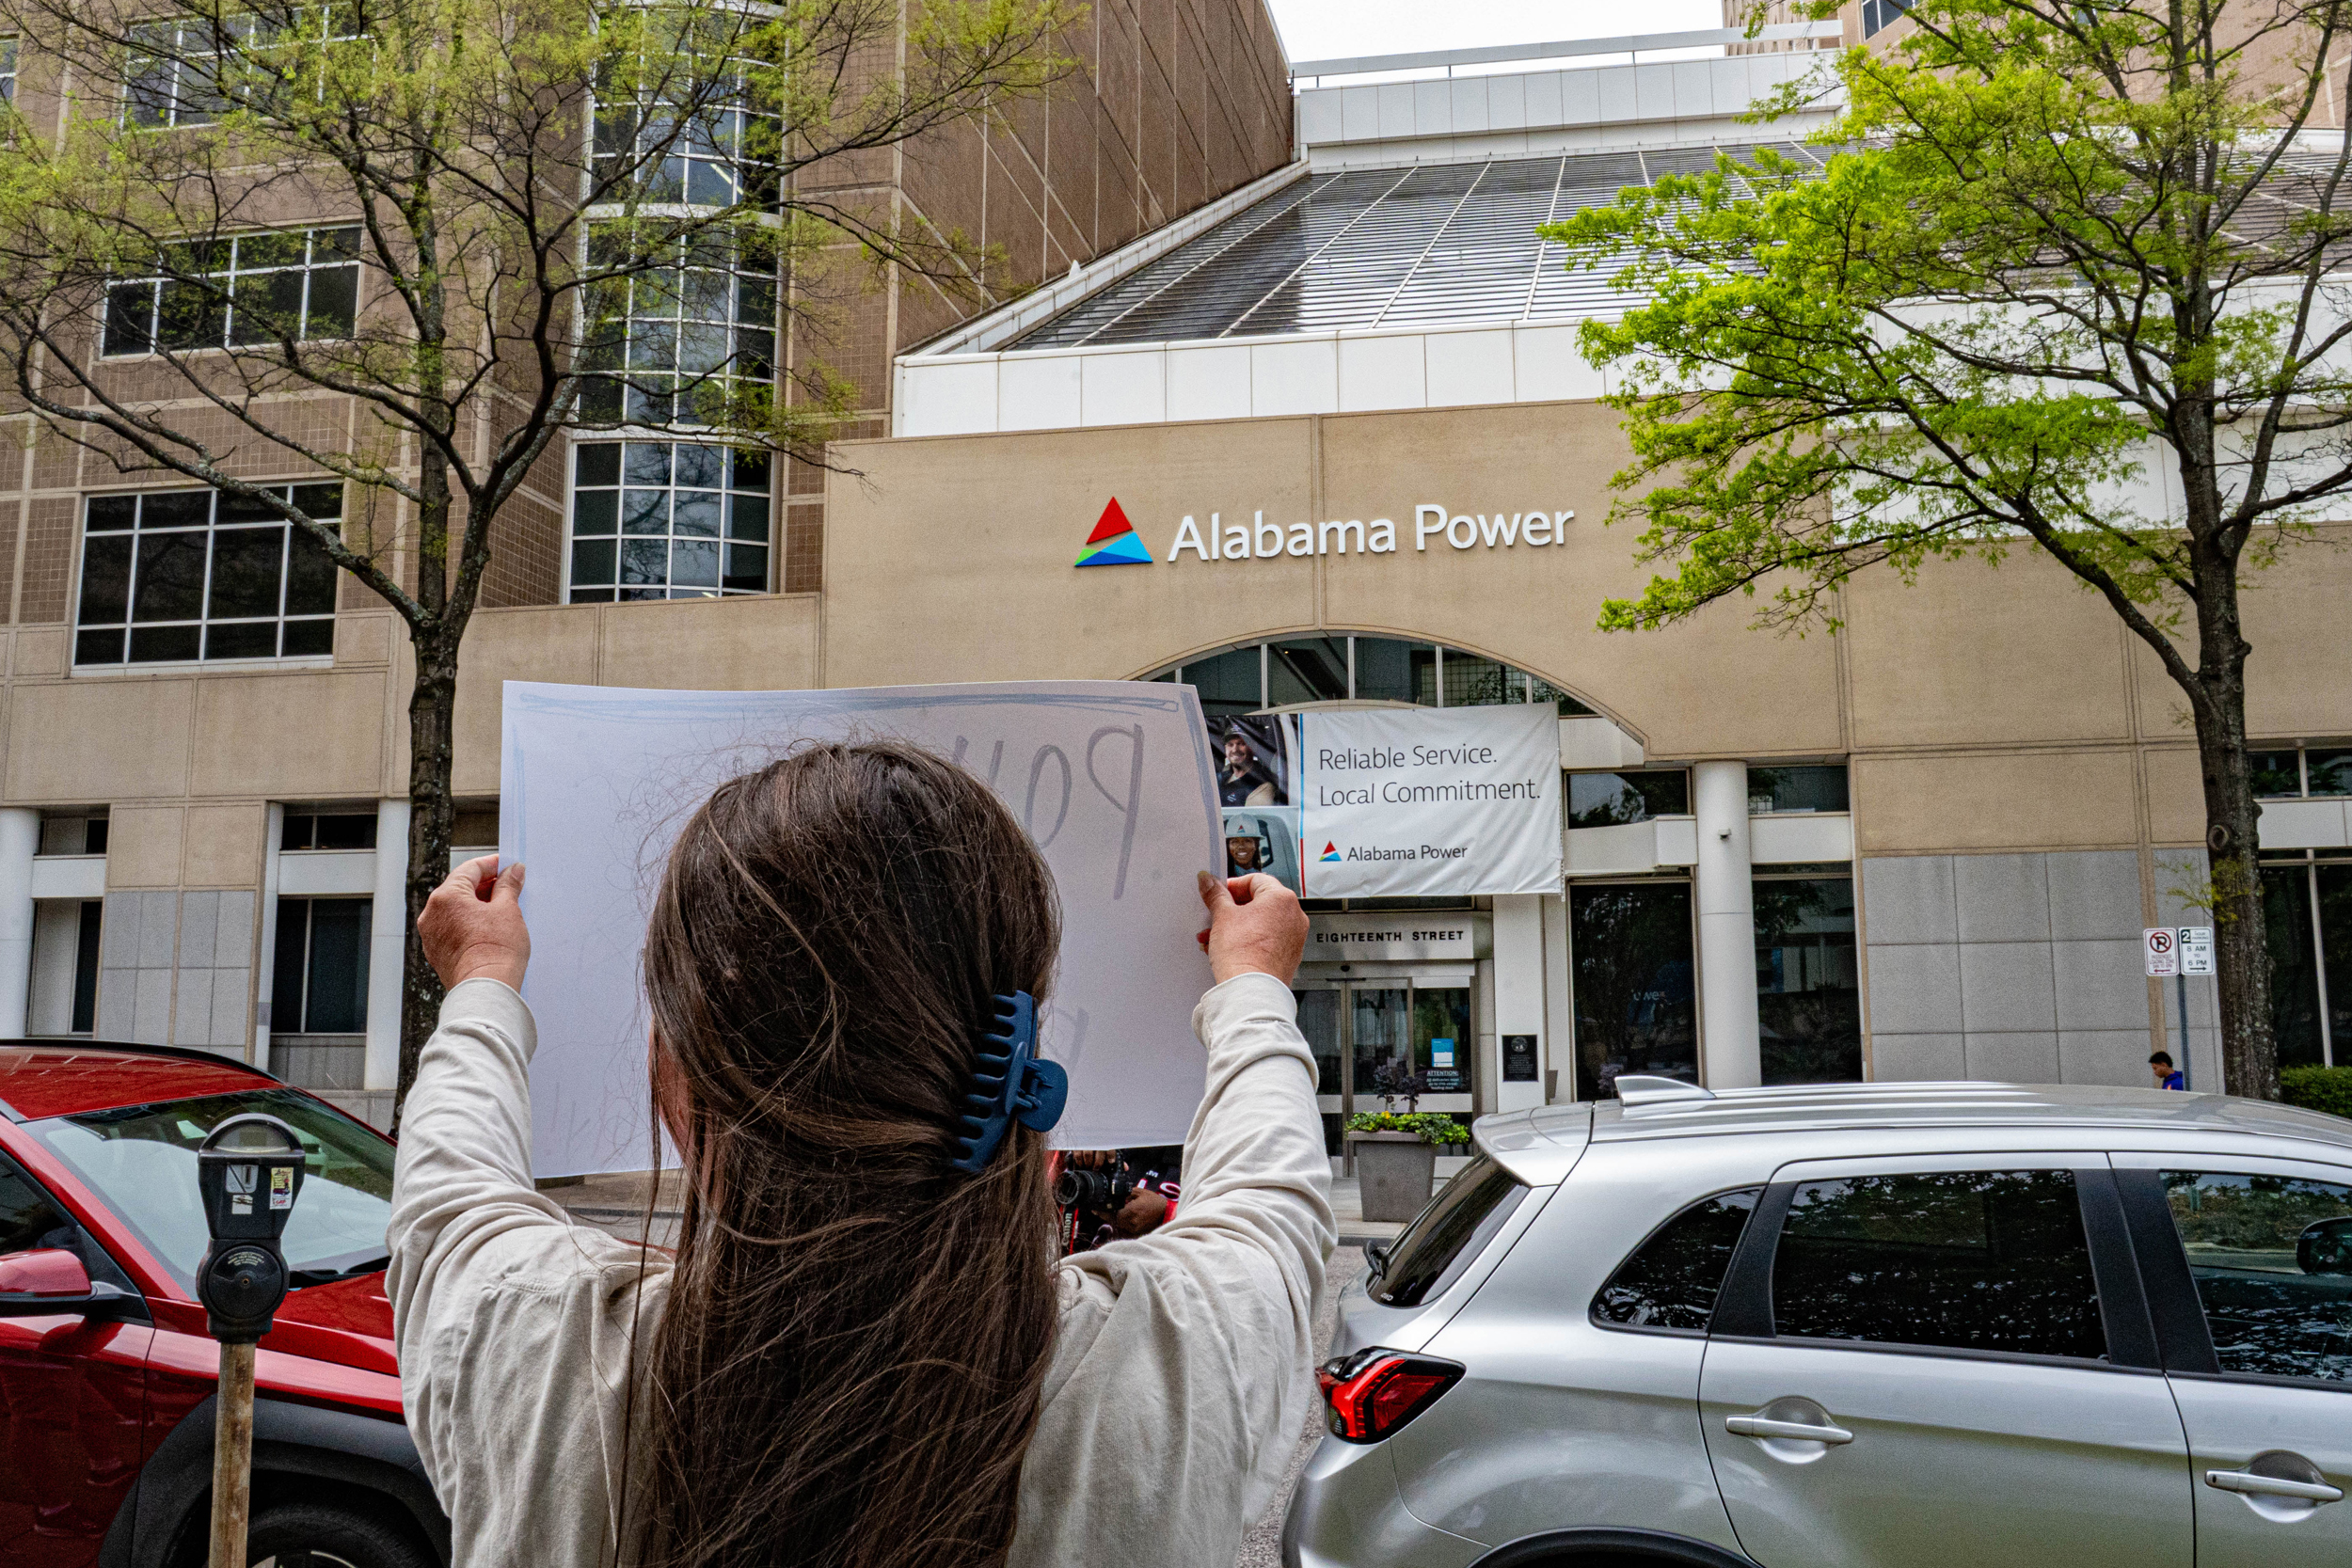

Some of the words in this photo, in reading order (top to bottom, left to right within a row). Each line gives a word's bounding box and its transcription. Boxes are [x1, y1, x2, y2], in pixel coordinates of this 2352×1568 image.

[1168, 510, 1396, 562] Alabama
[1415, 503, 1575, 551] Power
[1319, 746, 1406, 770] Reliable
[1412, 743, 1498, 767] Service.
[1319, 783, 1375, 807] Local
[1382, 778, 1541, 802] Commitment.
[1346, 846, 1416, 862] Alabama
[1421, 845, 1469, 860] Power
[1316, 931, 1402, 943] EIGHTEENTH
[1412, 930, 1464, 941] STREET
[2182, 930, 2190, 942] 2
[1061, 1212, 1073, 1246] Canon
